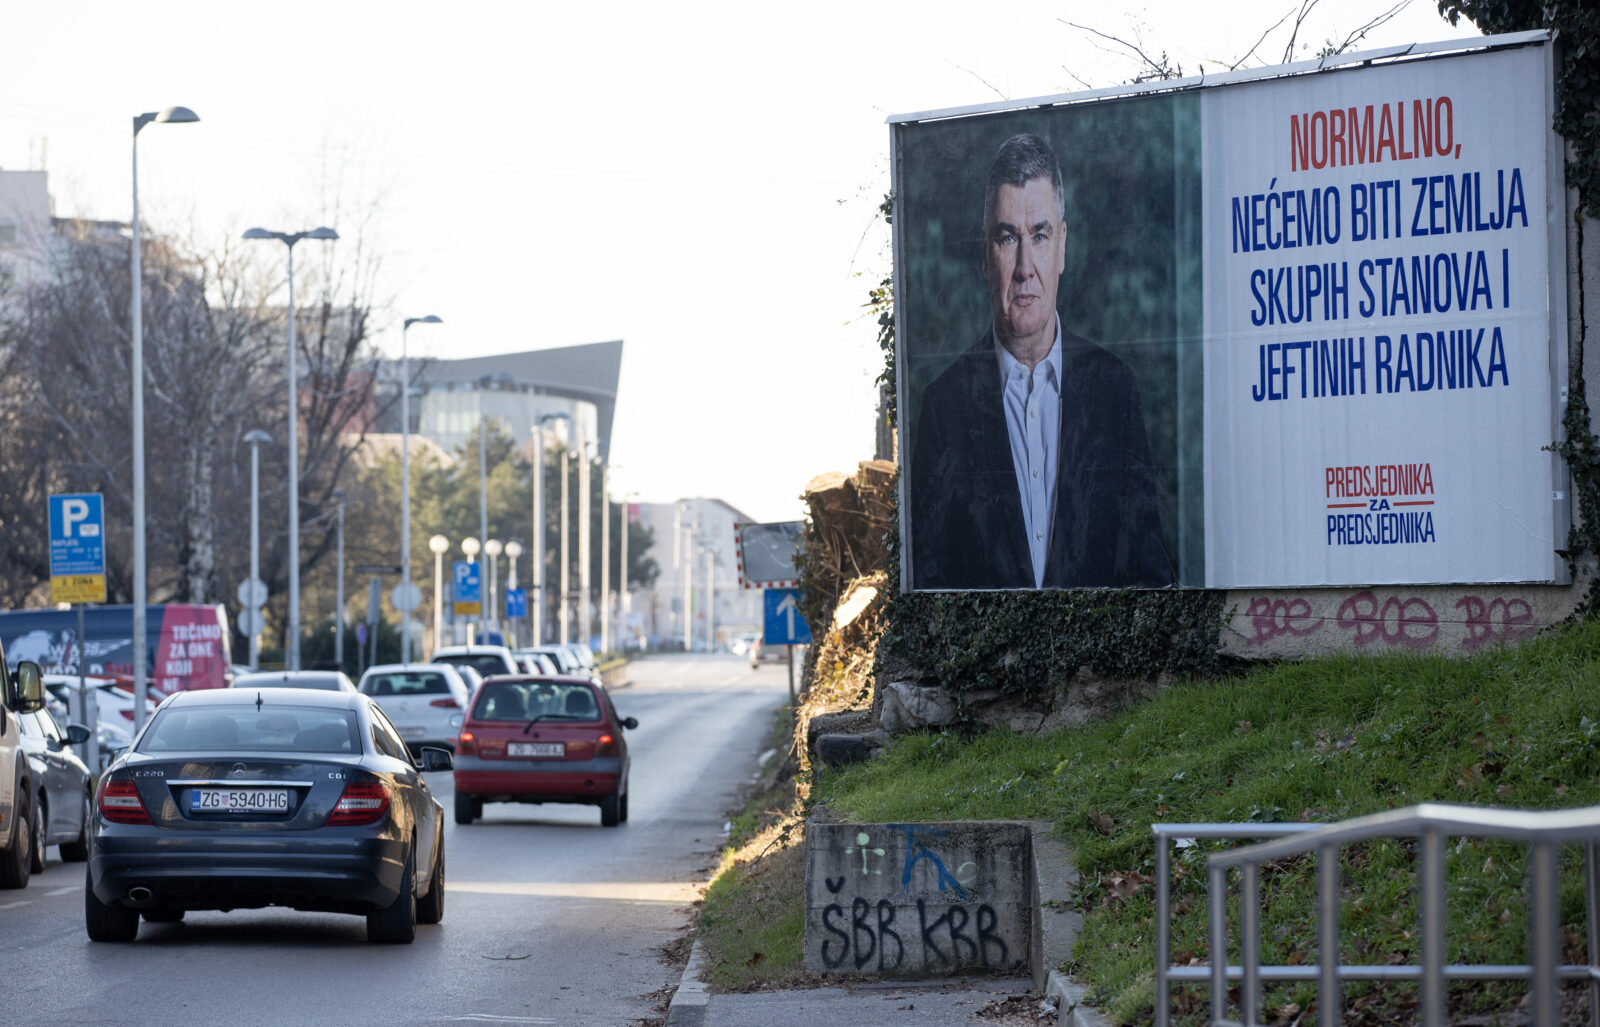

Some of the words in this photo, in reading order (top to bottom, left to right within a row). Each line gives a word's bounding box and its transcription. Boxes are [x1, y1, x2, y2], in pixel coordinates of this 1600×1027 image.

[1290, 96, 1462, 172] NORMALNO,
[1232, 177, 1341, 253] NEĆEMO
[1350, 179, 1401, 242] BITI
[1411, 168, 1529, 237] ZEMLJA
[1250, 261, 1349, 326] SKUPIH
[1358, 250, 1493, 318] STANOVA
[1502, 248, 1510, 309] I
[1252, 336, 1366, 402] JEFTINIH
[1375, 326, 1510, 395] RADNIKA
[1325, 462, 1435, 498] PREDSJEDNIKA
[63, 499, 90, 537] P
[1369, 498, 1391, 511] ZA
[1327, 511, 1436, 545] PREDSJEDNIKA
[172, 622, 221, 641] TRČIMO
[169, 642, 186, 659] ZA
[188, 641, 214, 658] ONE
[166, 660, 193, 676] KOJI
[202, 792, 220, 807] ZG
